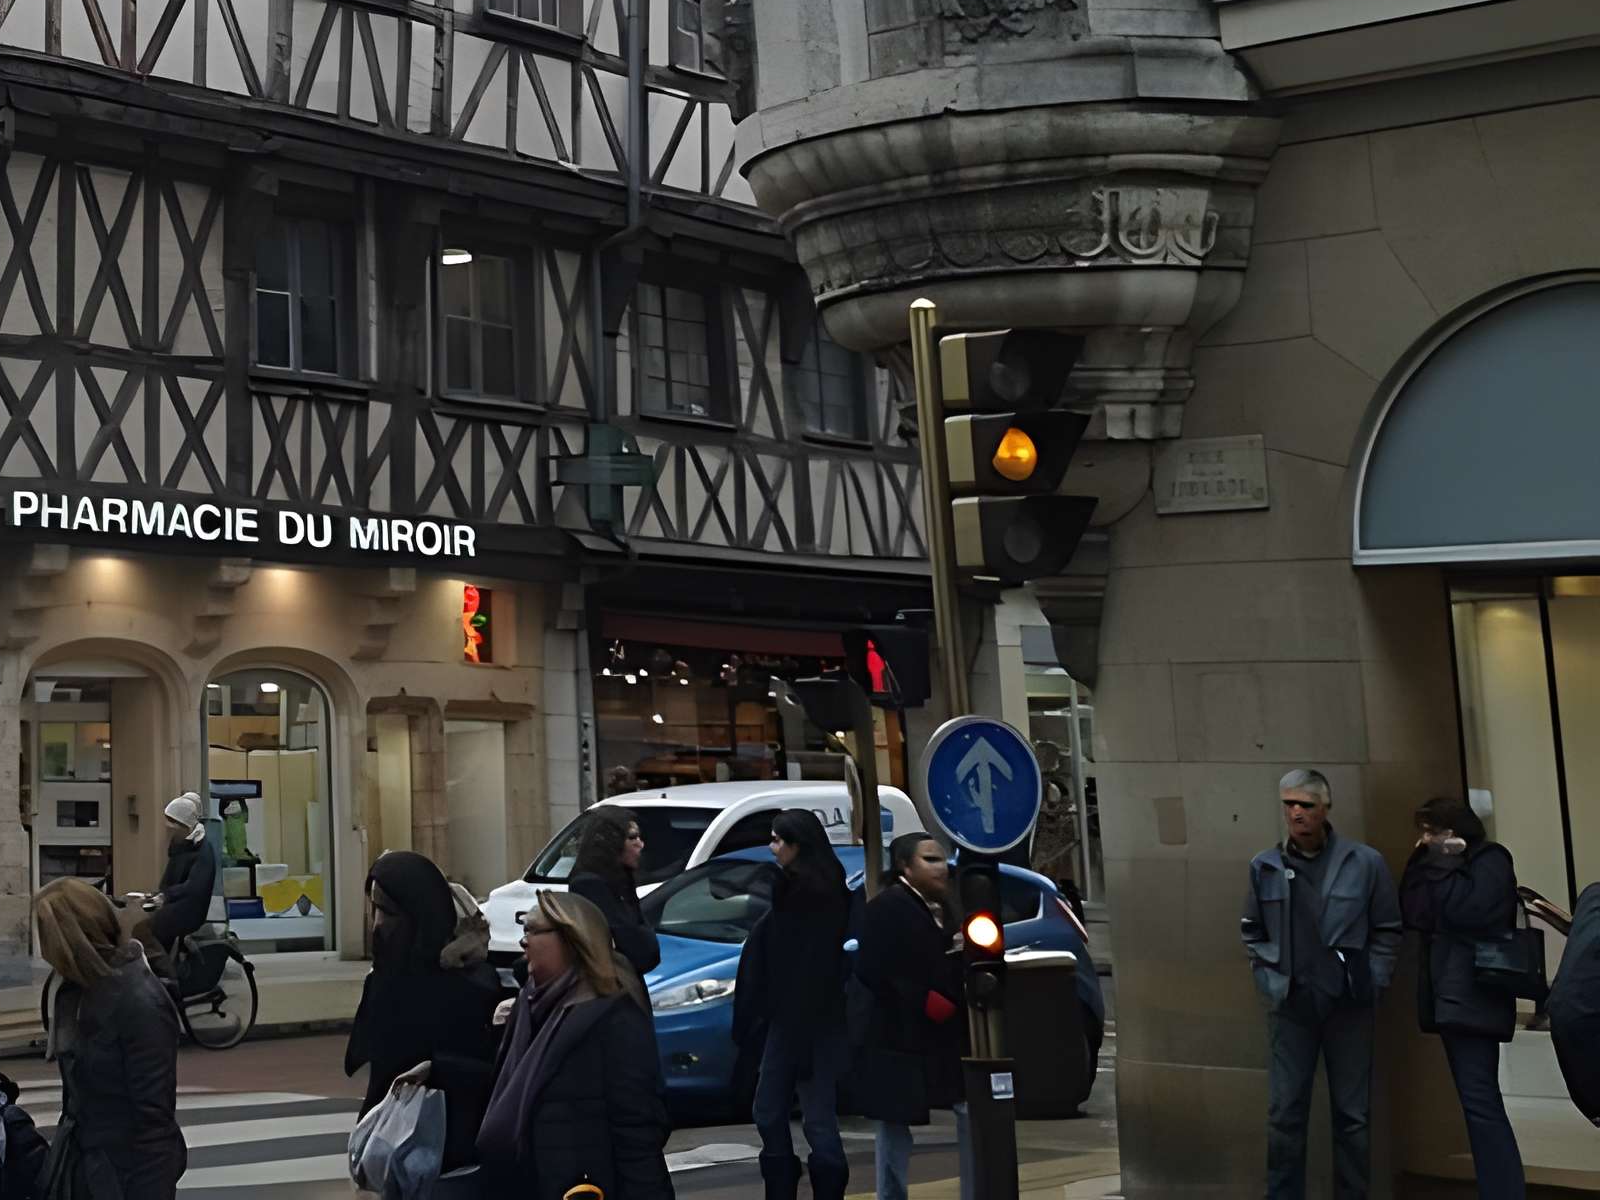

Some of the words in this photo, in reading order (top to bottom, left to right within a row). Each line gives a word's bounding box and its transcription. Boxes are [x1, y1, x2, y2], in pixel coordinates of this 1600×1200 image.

[13, 490, 259, 543] PHARMACIE
[278, 510, 332, 548] DU
[349, 516, 477, 557] MIROIR
